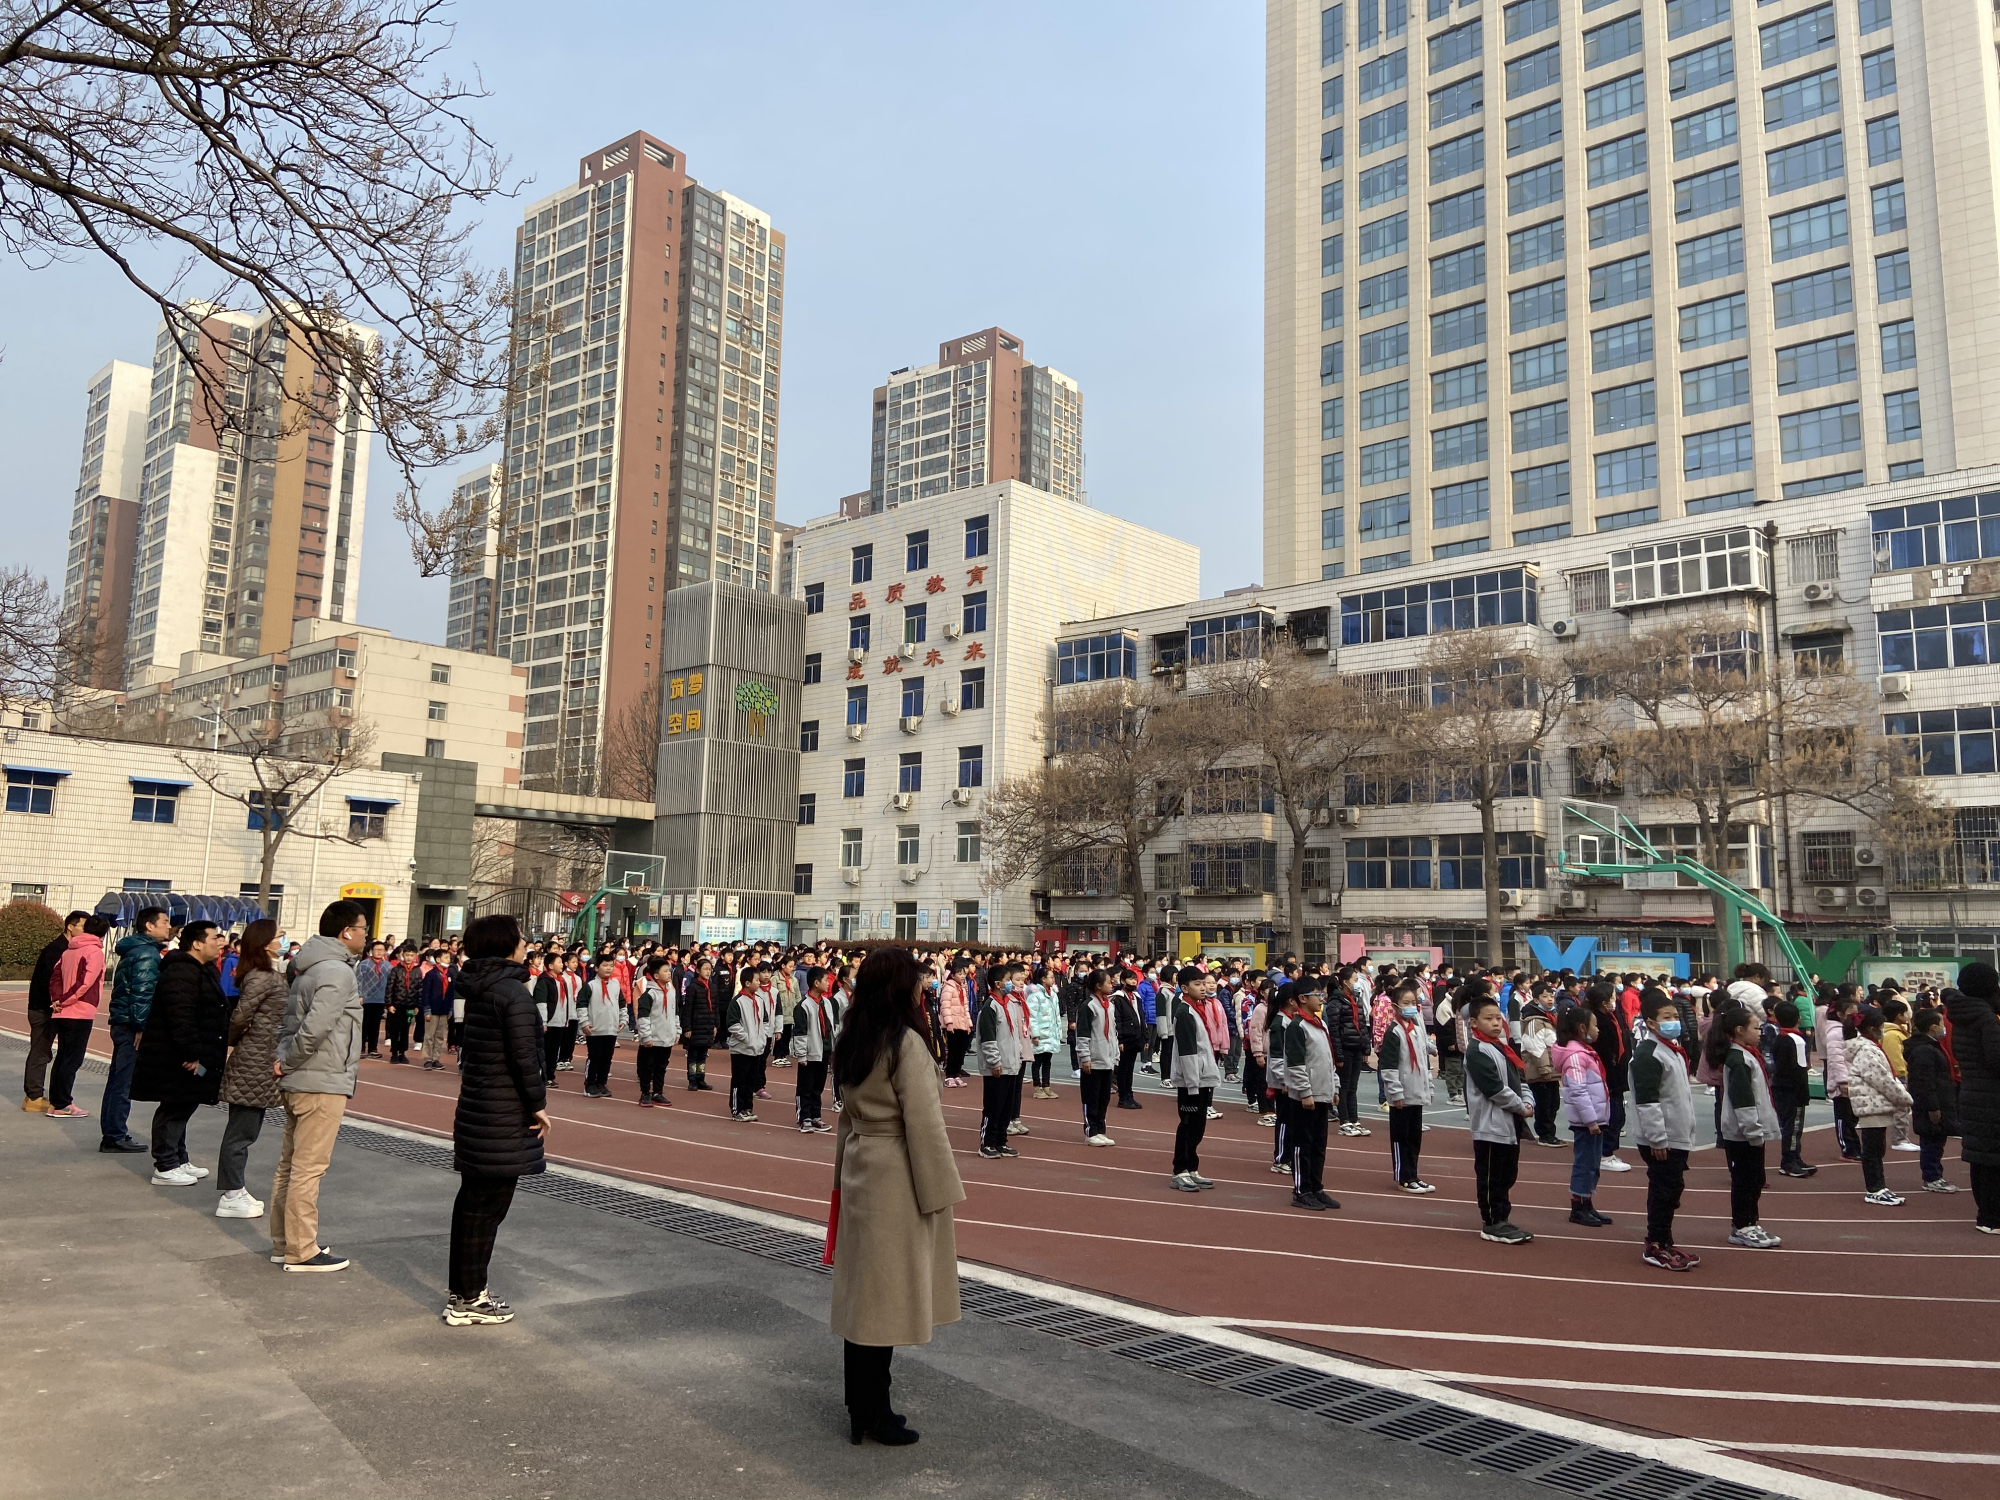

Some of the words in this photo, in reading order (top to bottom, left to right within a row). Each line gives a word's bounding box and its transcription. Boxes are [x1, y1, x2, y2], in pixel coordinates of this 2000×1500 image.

[848, 565, 989, 612] 品质教育
[845, 640, 987, 681] 成就未来
[669, 672, 704, 700] 筑梦
[667, 709, 702, 735] 空间
